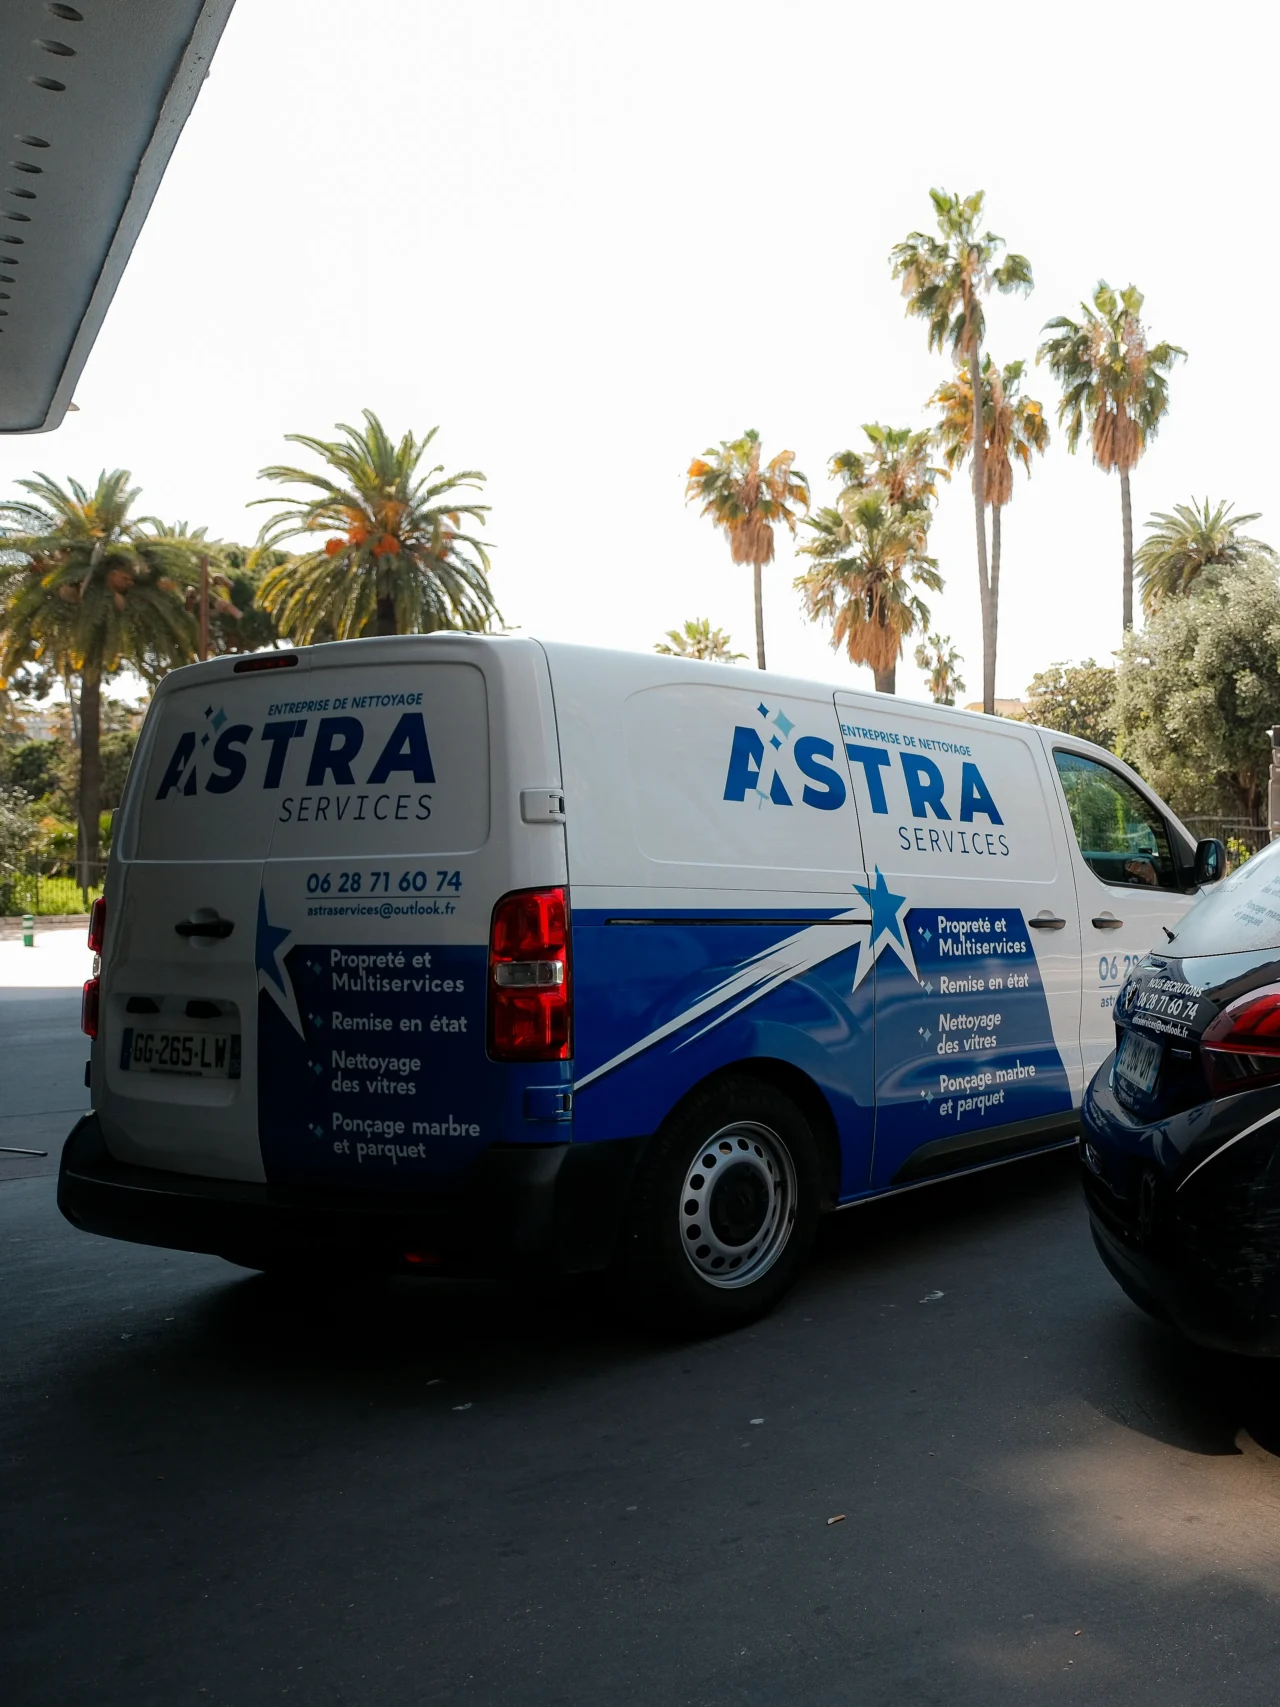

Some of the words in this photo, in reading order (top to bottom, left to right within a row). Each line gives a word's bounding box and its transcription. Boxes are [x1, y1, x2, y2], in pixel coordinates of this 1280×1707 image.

[268, 698, 330, 716] ENTREPRISE
[332, 697, 348, 711] DE
[352, 693, 424, 710] NETTOYAGE
[840, 724, 901, 745] ENTREPRISE
[902, 735, 917, 748] DE
[918, 738, 972, 757] NETTOYAGE
[155, 712, 436, 801] ASTRA
[723, 725, 1005, 826] ASTRA
[278, 794, 432, 823] SERVICES
[898, 826, 1010, 857] SERVICES
[306, 872, 331, 894] 06
[337, 871, 362, 894] 28
[369, 871, 391, 893] 71
[398, 870, 428, 893] 60
[436, 870, 463, 893] 74
[307, 900, 457, 920] astraservices@outlook.fr
[938, 915, 991, 942] Propreté
[994, 918, 1007, 933] et
[939, 937, 1027, 957] Multiservices
[330, 949, 406, 975] Propreté
[412, 952, 432, 968] et
[1098, 956, 1118, 981] 06
[331, 970, 465, 993] Multiservices
[940, 975, 985, 994] Remise
[988, 976, 1004, 991] en
[1008, 972, 1029, 989] état
[1163, 980, 1204, 998] RECRUTONS
[1137, 992, 1148, 1007] 06
[1146, 993, 1158, 1009] 28
[1156, 995, 1170, 1012] 71
[1167, 998, 1183, 1016] 60
[1182, 1001, 1199, 1020] 74
[331, 1011, 394, 1032] Remise
[399, 1017, 423, 1033] en
[430, 1014, 468, 1034] état
[938, 1012, 1002, 1034] Nettoyage
[133, 1033, 227, 1069] GG-265-LW
[937, 1034, 959, 1056] des
[962, 1033, 997, 1052] vitres
[331, 1050, 422, 1077] Nettoyage
[331, 1076, 360, 1094] des
[366, 1076, 417, 1096] vitres
[940, 1071, 993, 1096] Ponçage
[996, 1060, 1036, 1082] marbre
[939, 1102, 953, 1117] et
[957, 1090, 1005, 1121] parquet
[332, 1112, 406, 1140] Ponçage
[412, 1116, 481, 1138] marbre
[333, 1139, 350, 1155] et
[356, 1141, 427, 1165] parquet
